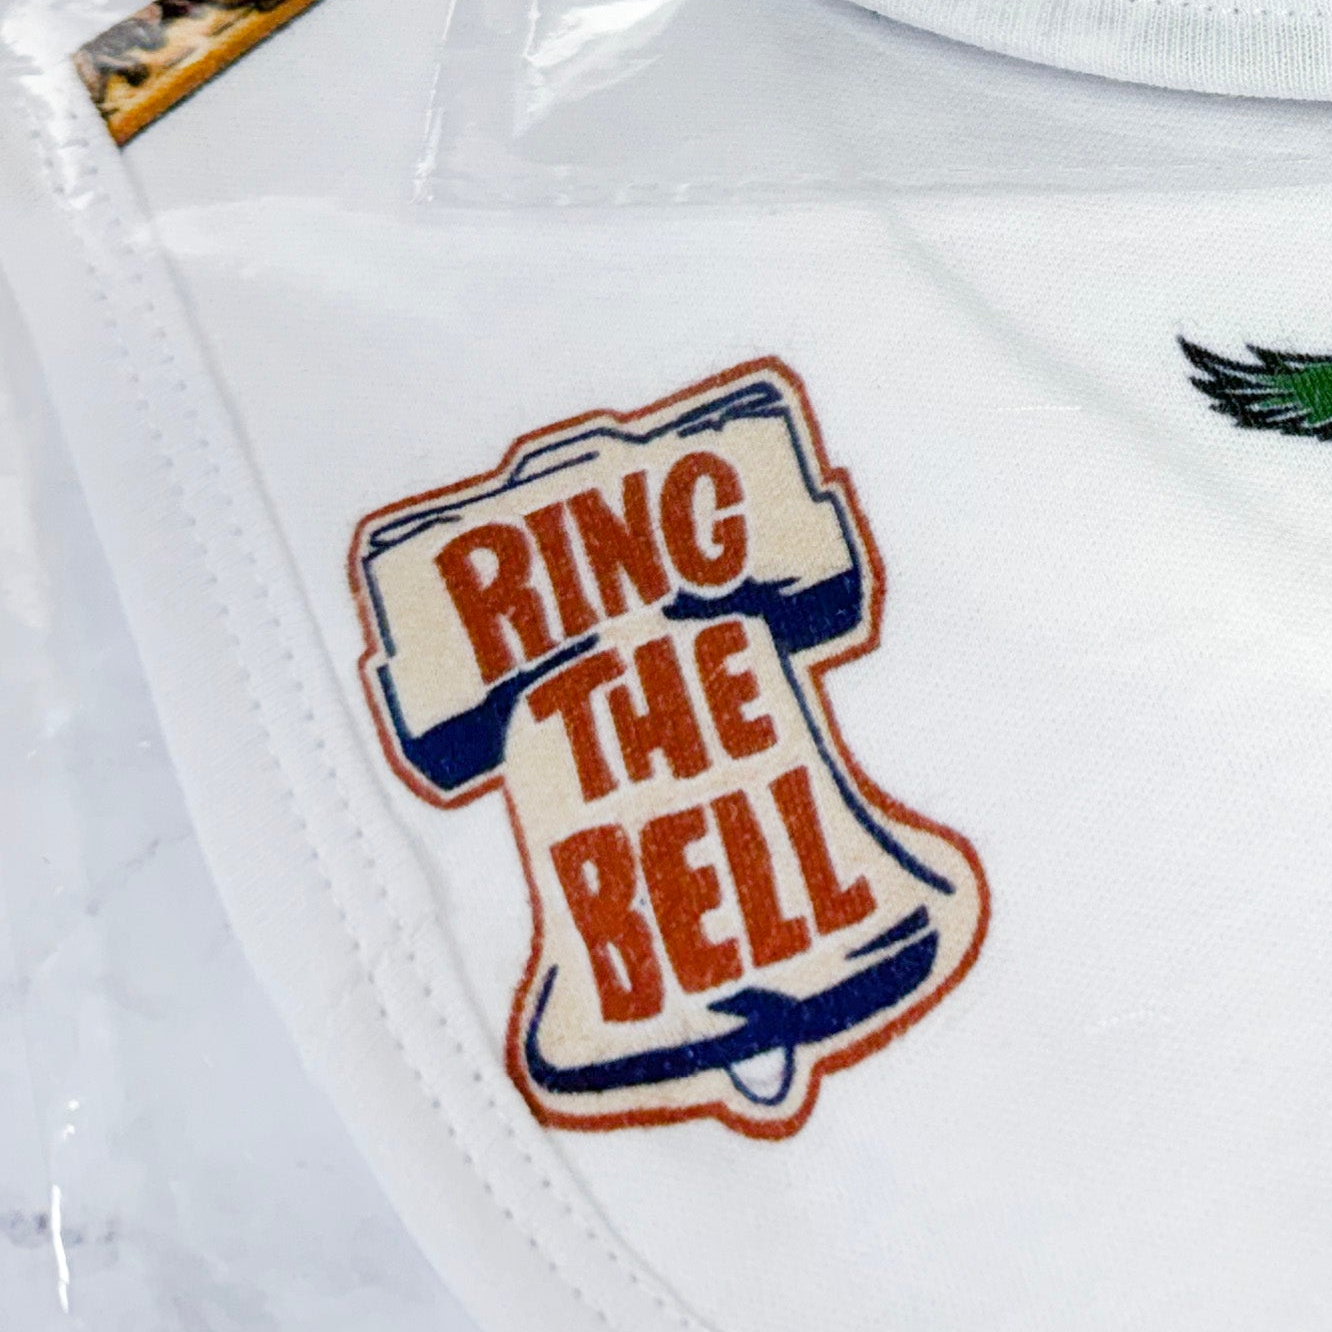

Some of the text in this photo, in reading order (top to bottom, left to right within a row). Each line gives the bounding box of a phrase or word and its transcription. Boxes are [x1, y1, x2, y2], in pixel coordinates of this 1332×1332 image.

[434, 451, 748, 684] RING
[526, 621, 777, 802] THE
[549, 766, 878, 1023] BELL
